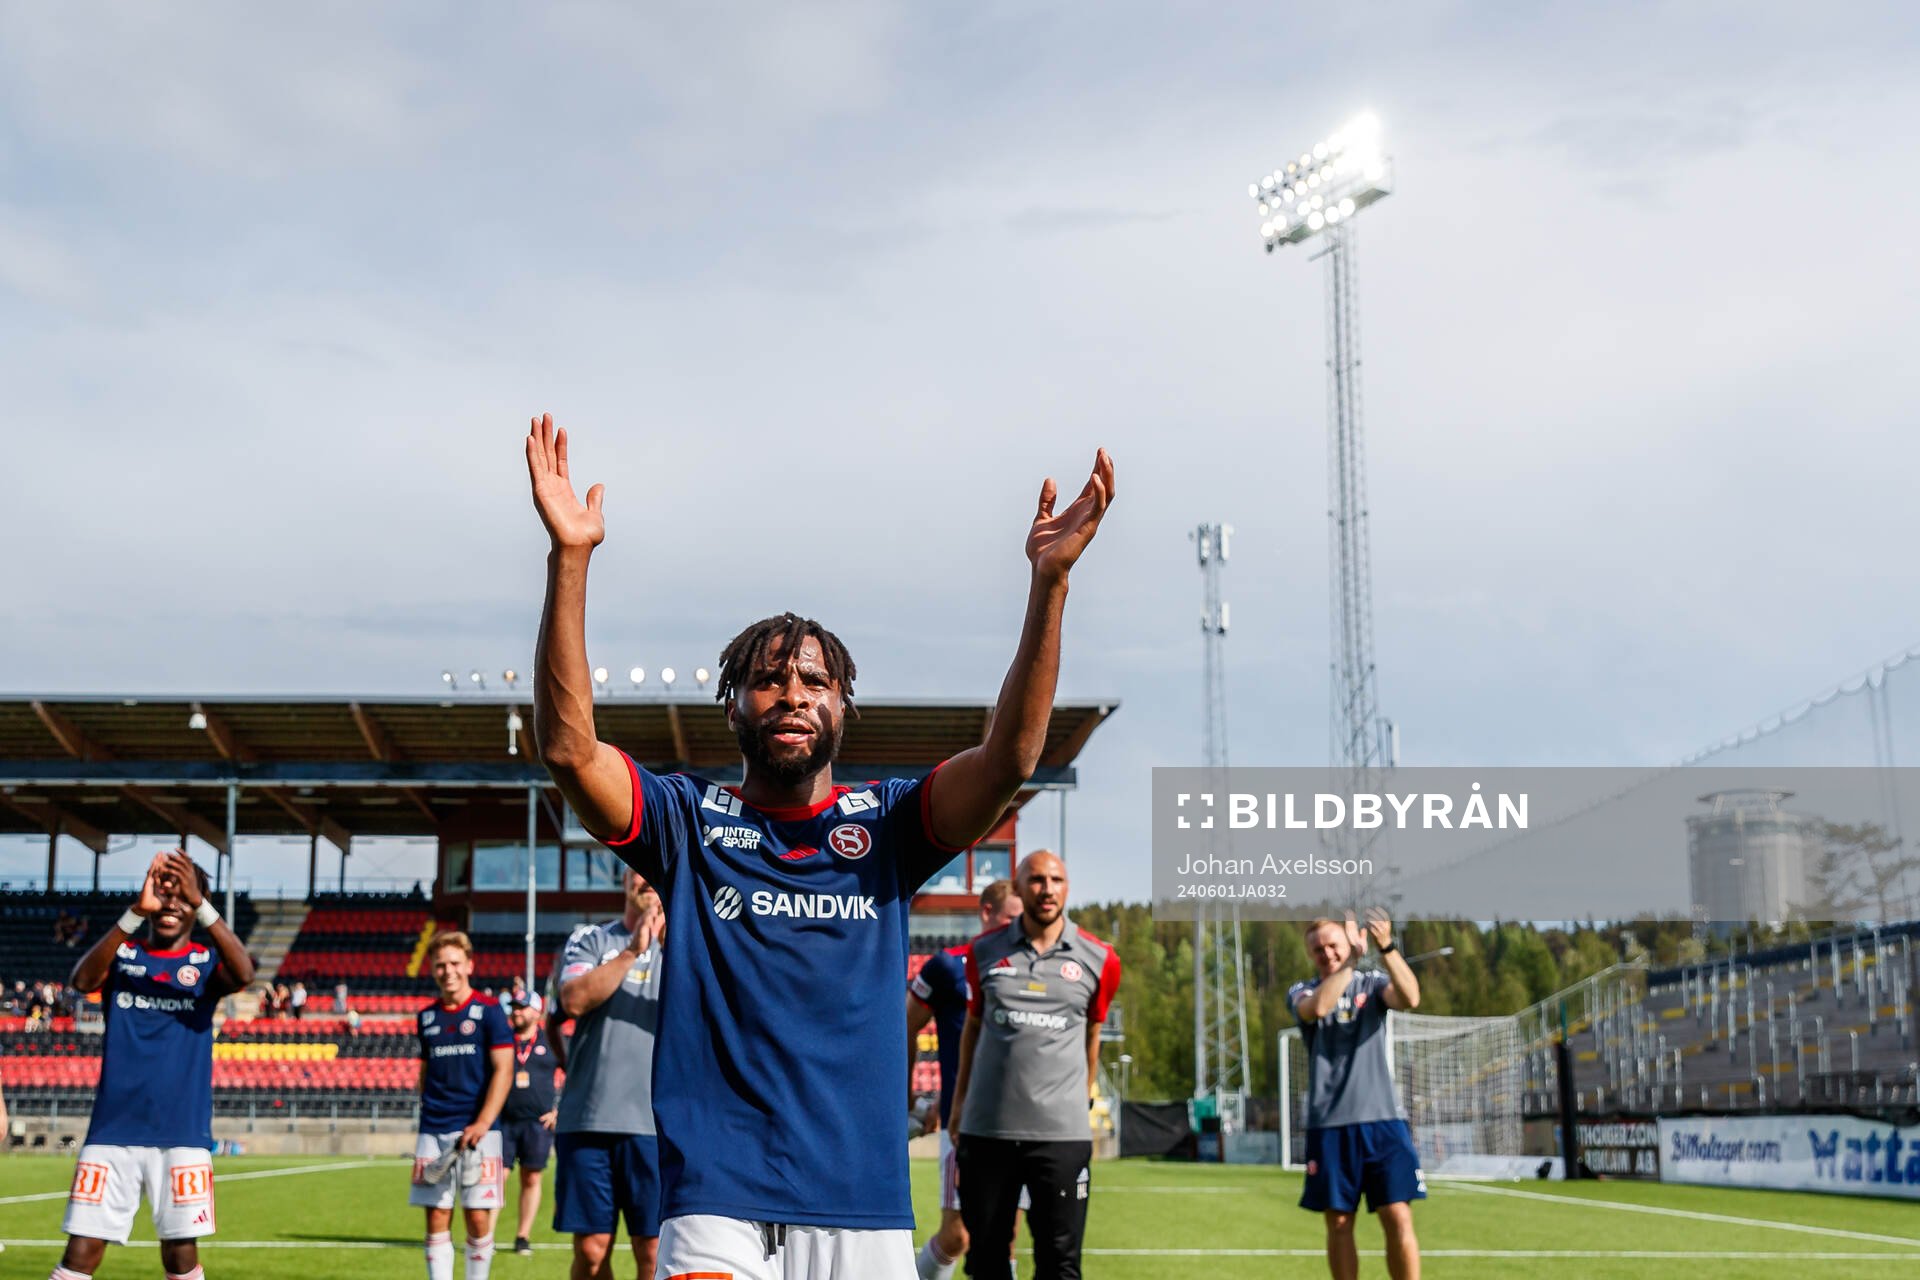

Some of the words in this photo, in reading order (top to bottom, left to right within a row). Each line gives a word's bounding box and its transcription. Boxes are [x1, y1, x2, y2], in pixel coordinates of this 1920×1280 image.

[724, 826, 761, 840] INTER
[722, 837, 760, 850] SPORT
[751, 891, 878, 920] SANDVIK
